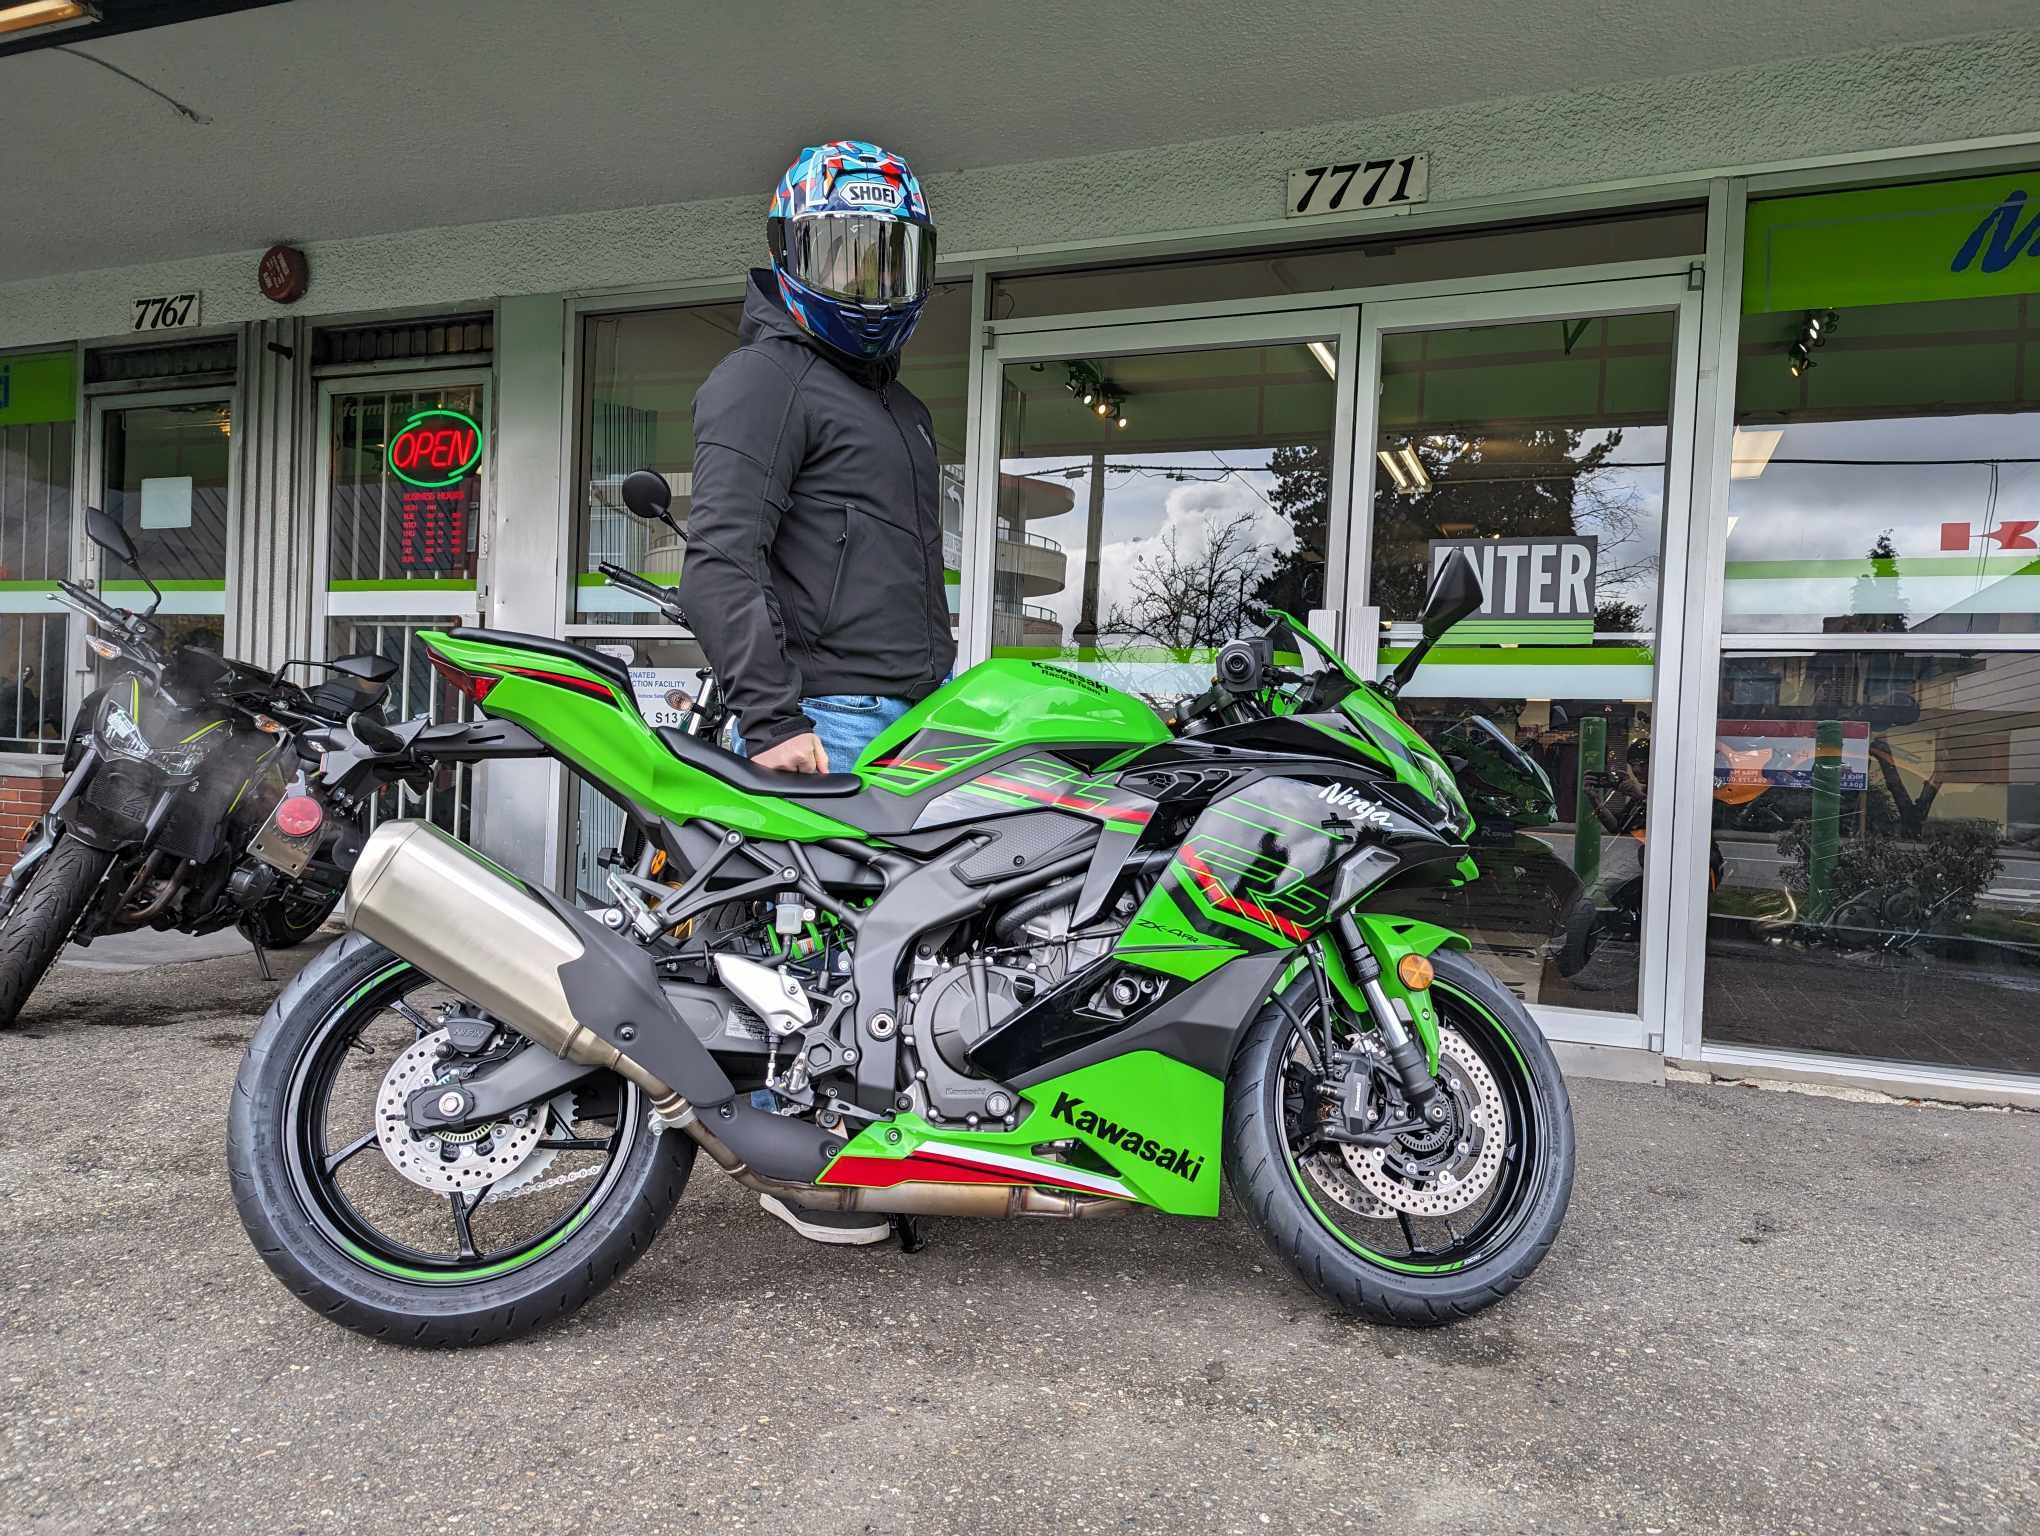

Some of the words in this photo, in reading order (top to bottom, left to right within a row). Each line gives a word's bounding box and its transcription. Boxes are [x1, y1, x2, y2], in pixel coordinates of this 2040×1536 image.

[849, 186, 895, 204] SHOEI
[1297, 156, 1415, 212] 7771
[135, 295, 195, 330] 7767
[393, 428, 475, 468] OPEN
[654, 680, 686, 688] FACILITY
[1031, 661, 1109, 694] Kawasaki
[1041, 669, 1075, 686] Racing
[1077, 681, 1101, 696] Team
[1318, 782, 1394, 828] Ninja
[1050, 1091, 1205, 1183] Kawasaki
